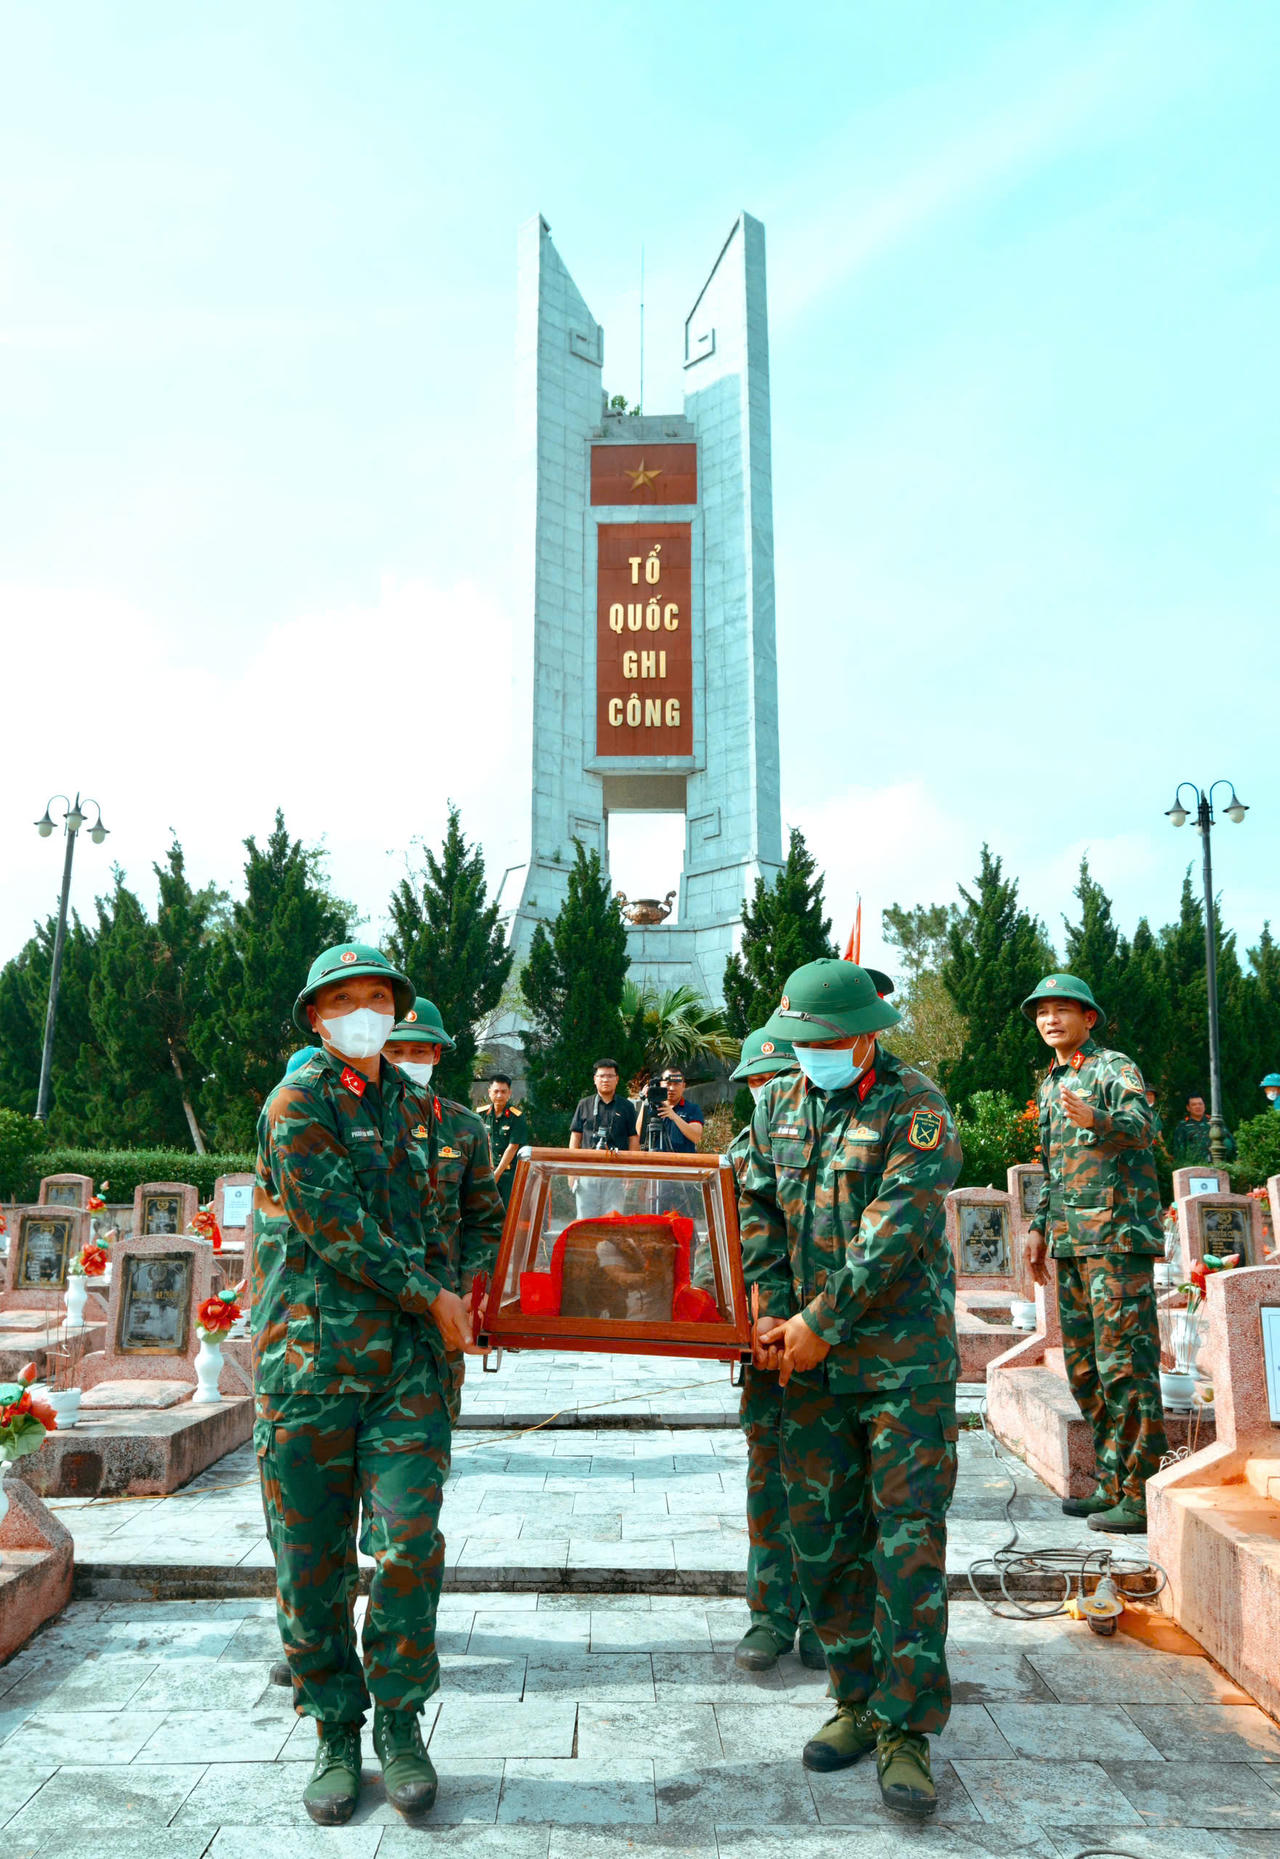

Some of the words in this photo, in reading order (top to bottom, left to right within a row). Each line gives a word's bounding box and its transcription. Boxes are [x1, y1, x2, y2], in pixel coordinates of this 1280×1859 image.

[628, 544, 662, 584] TỔ
[609, 594, 679, 634] QUỐC
[623, 650, 667, 679] GHI
[608, 692, 681, 727] CÔNG
